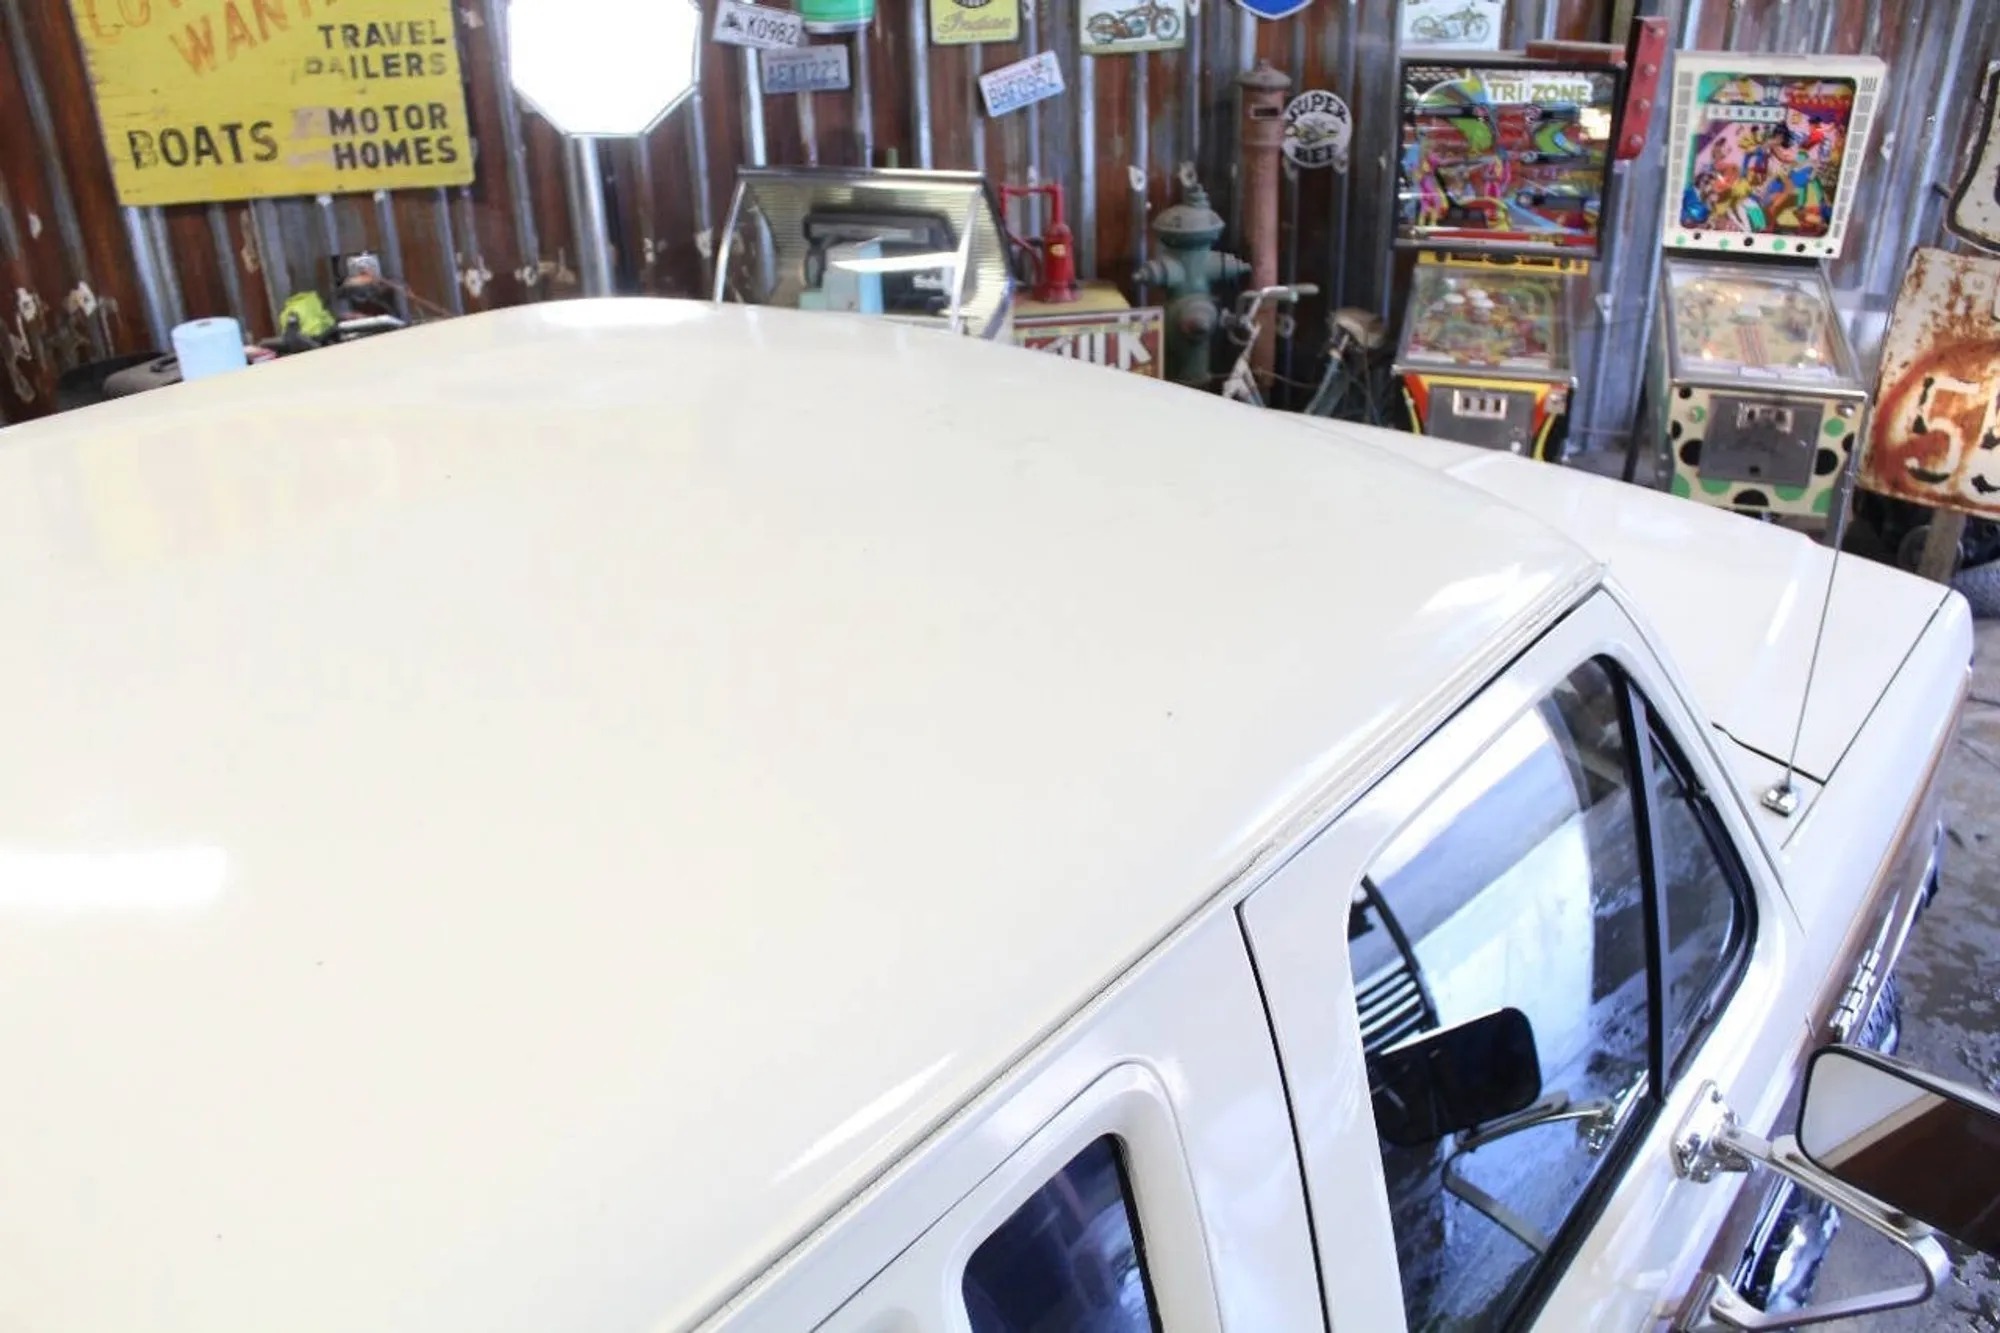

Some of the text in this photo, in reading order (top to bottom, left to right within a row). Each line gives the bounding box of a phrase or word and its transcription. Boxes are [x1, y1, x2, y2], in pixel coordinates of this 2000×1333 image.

[318, 20, 446, 48] TRAVEL
[289, 52, 447, 84] RAILERS
[1288, 93, 1347, 125] SUPER
[1489, 82, 1589, 104] TRI ZONE
[328, 103, 448, 136] MOTOR
[127, 120, 278, 169] BOATS
[332, 136, 457, 170] HOMES
